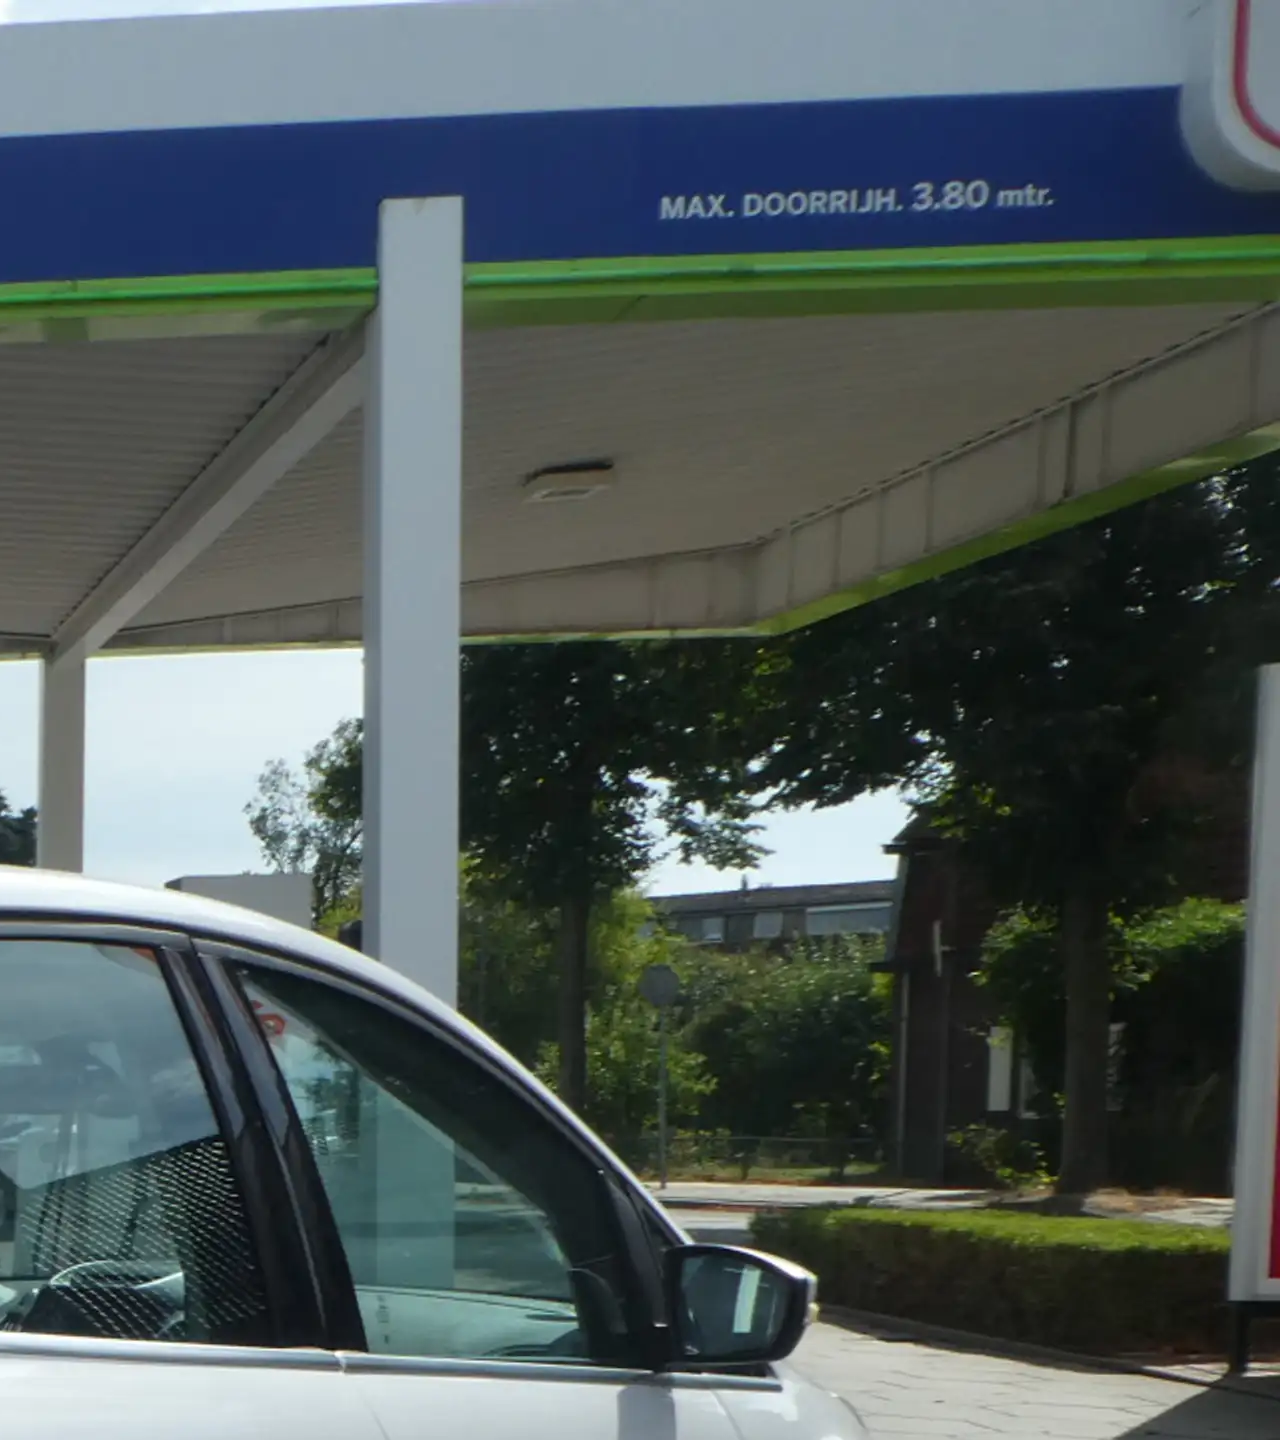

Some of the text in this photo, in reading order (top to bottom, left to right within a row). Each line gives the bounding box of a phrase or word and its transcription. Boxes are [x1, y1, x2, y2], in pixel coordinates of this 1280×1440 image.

[659, 180, 1055, 220] MAX. DOORRIJH. 3.80 mtr.
